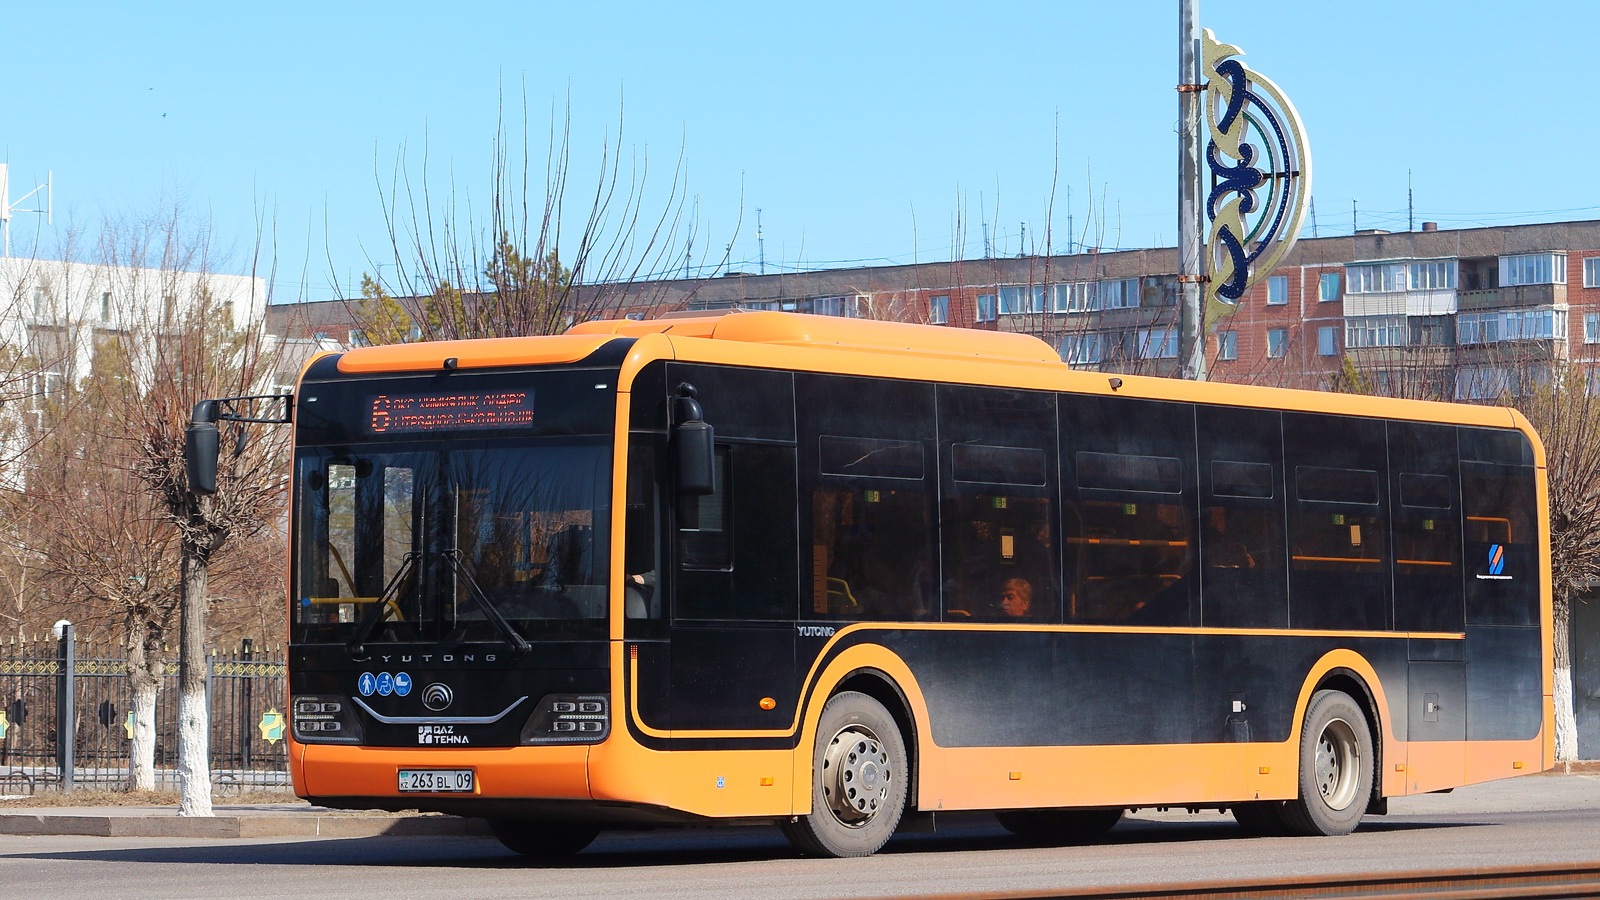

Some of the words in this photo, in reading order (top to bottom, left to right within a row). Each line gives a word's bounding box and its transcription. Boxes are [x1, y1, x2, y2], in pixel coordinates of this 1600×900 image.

[371, 395, 391, 432] 6
[797, 625, 836, 637] YUTONG
[381, 654, 497, 662] YUTONG
[433, 725, 454, 735] QAZ
[433, 735, 470, 744] TEHNA
[411, 773, 434, 789] 263
[436, 776, 451, 789] BL
[456, 773, 471, 789] 09
